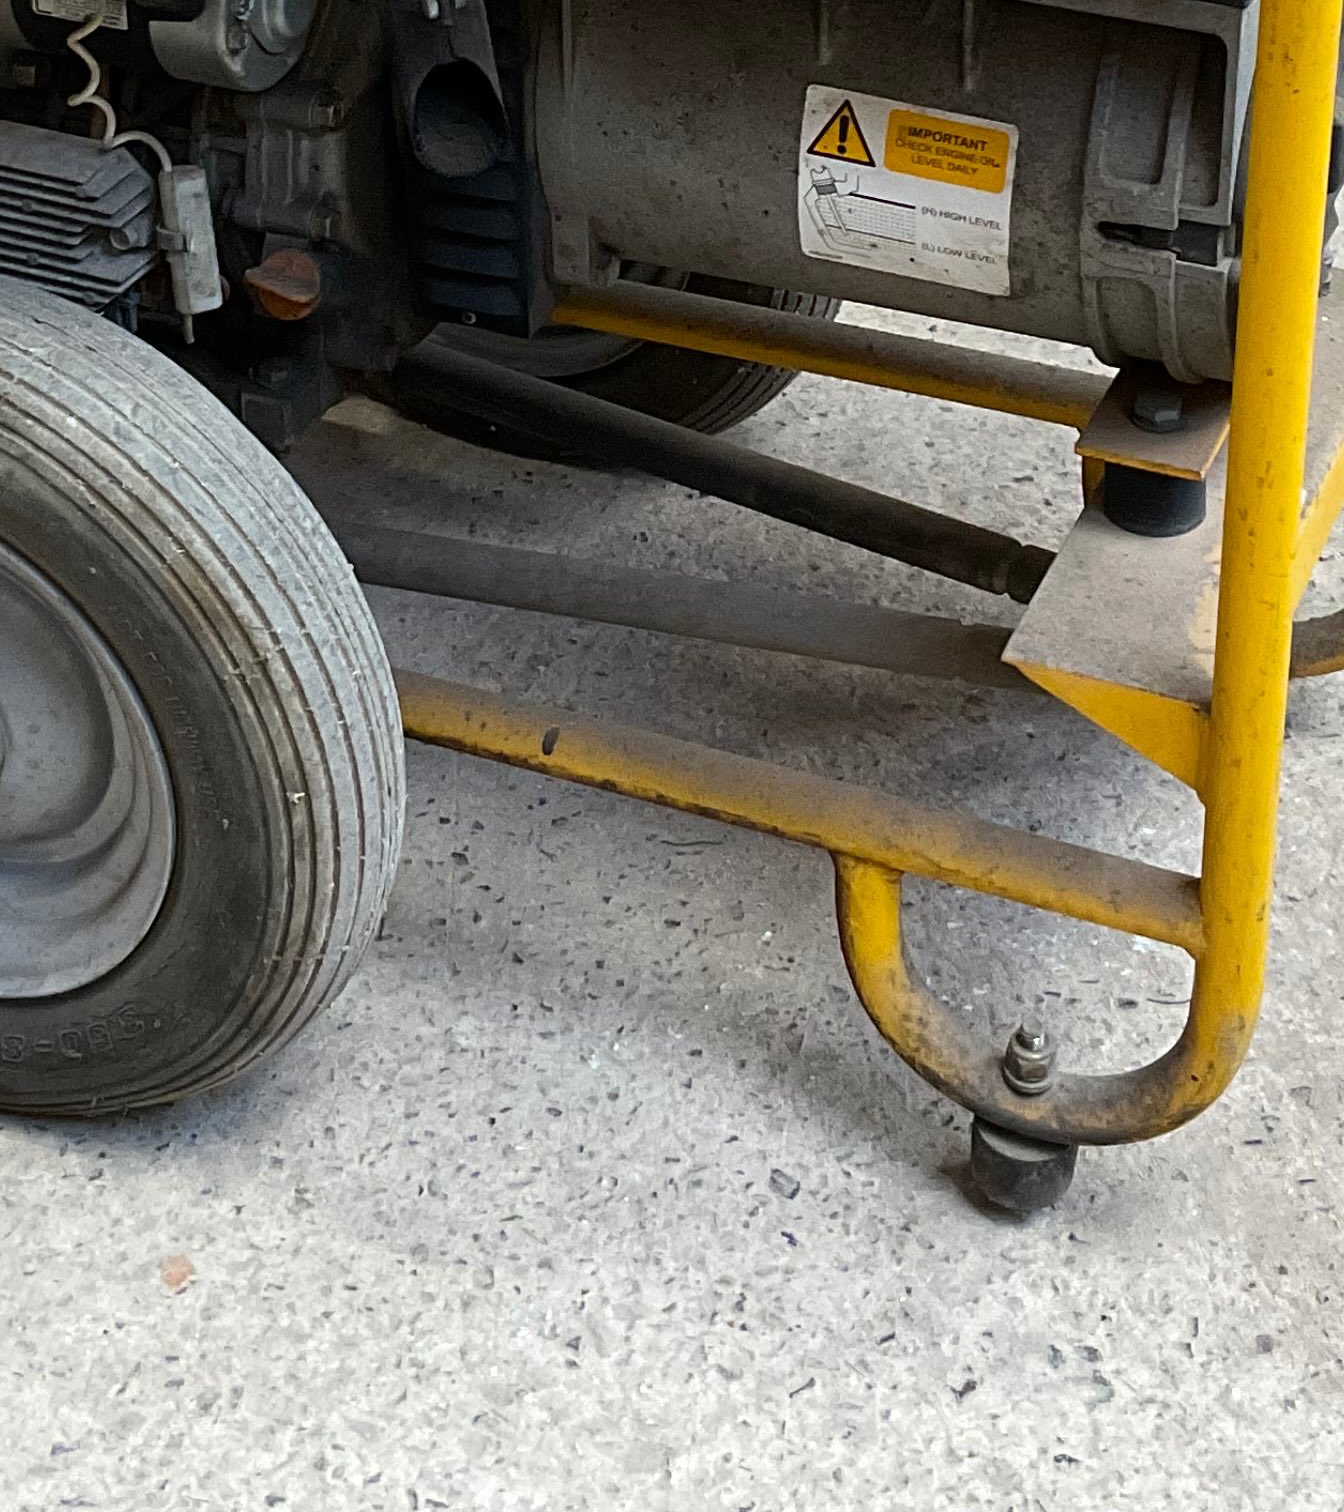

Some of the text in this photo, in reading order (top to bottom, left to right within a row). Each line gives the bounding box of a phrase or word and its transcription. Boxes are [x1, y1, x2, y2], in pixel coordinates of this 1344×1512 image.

[895, 137, 933, 153] CHECK
[936, 146, 977, 164] ENGINE
[907, 126, 989, 152] IMPORTANT
[911, 153, 979, 176] LEVEL DAILY
[939, 210, 967, 223] HIGH
[969, 215, 1003, 231] LEVEL
[937, 246, 963, 258] LOW
[965, 251, 997, 265] LEVEL
